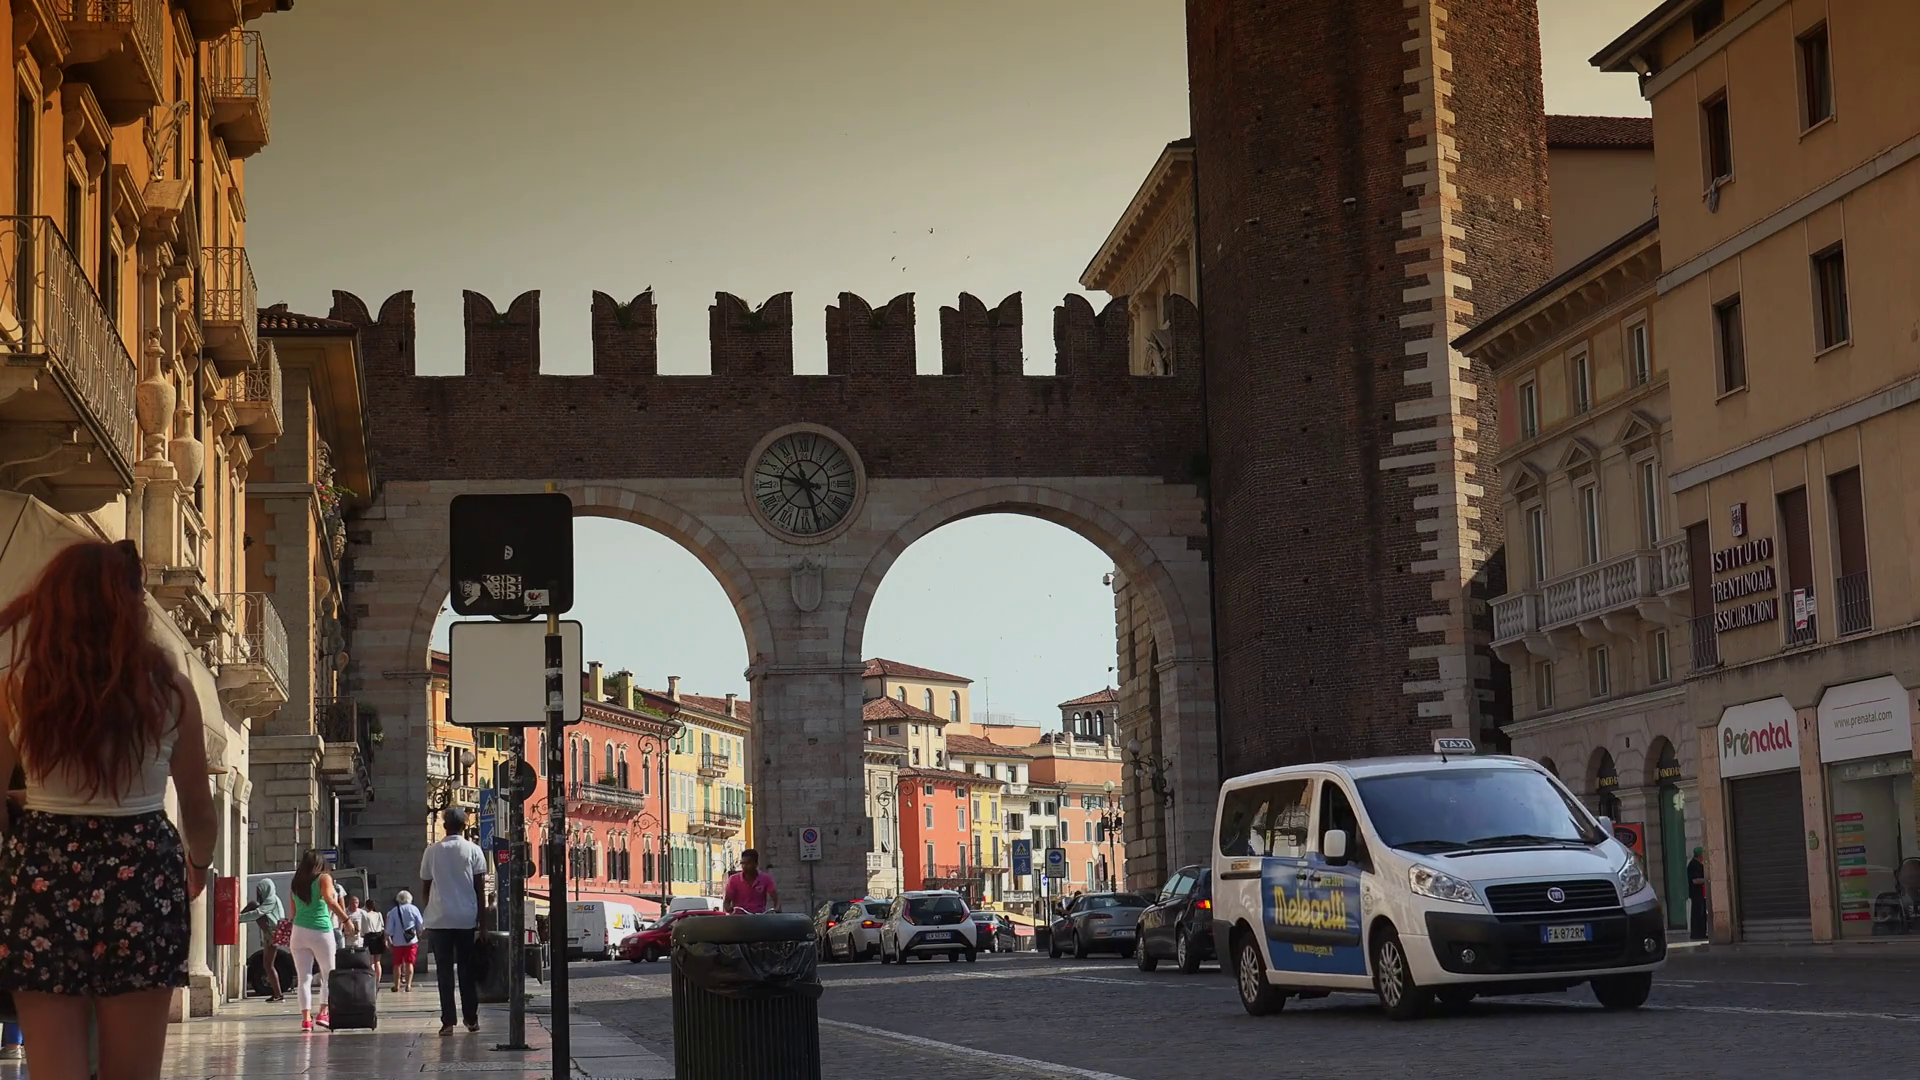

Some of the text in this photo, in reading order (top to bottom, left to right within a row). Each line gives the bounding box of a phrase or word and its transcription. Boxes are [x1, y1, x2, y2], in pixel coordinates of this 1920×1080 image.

[1711, 538, 1769, 573] ISTITUTO
[1714, 599, 1774, 633] ASSICURAZIONI
[1833, 710, 1893, 728] www.prenatal.com
[1440, 740, 1471, 748] TAXI
